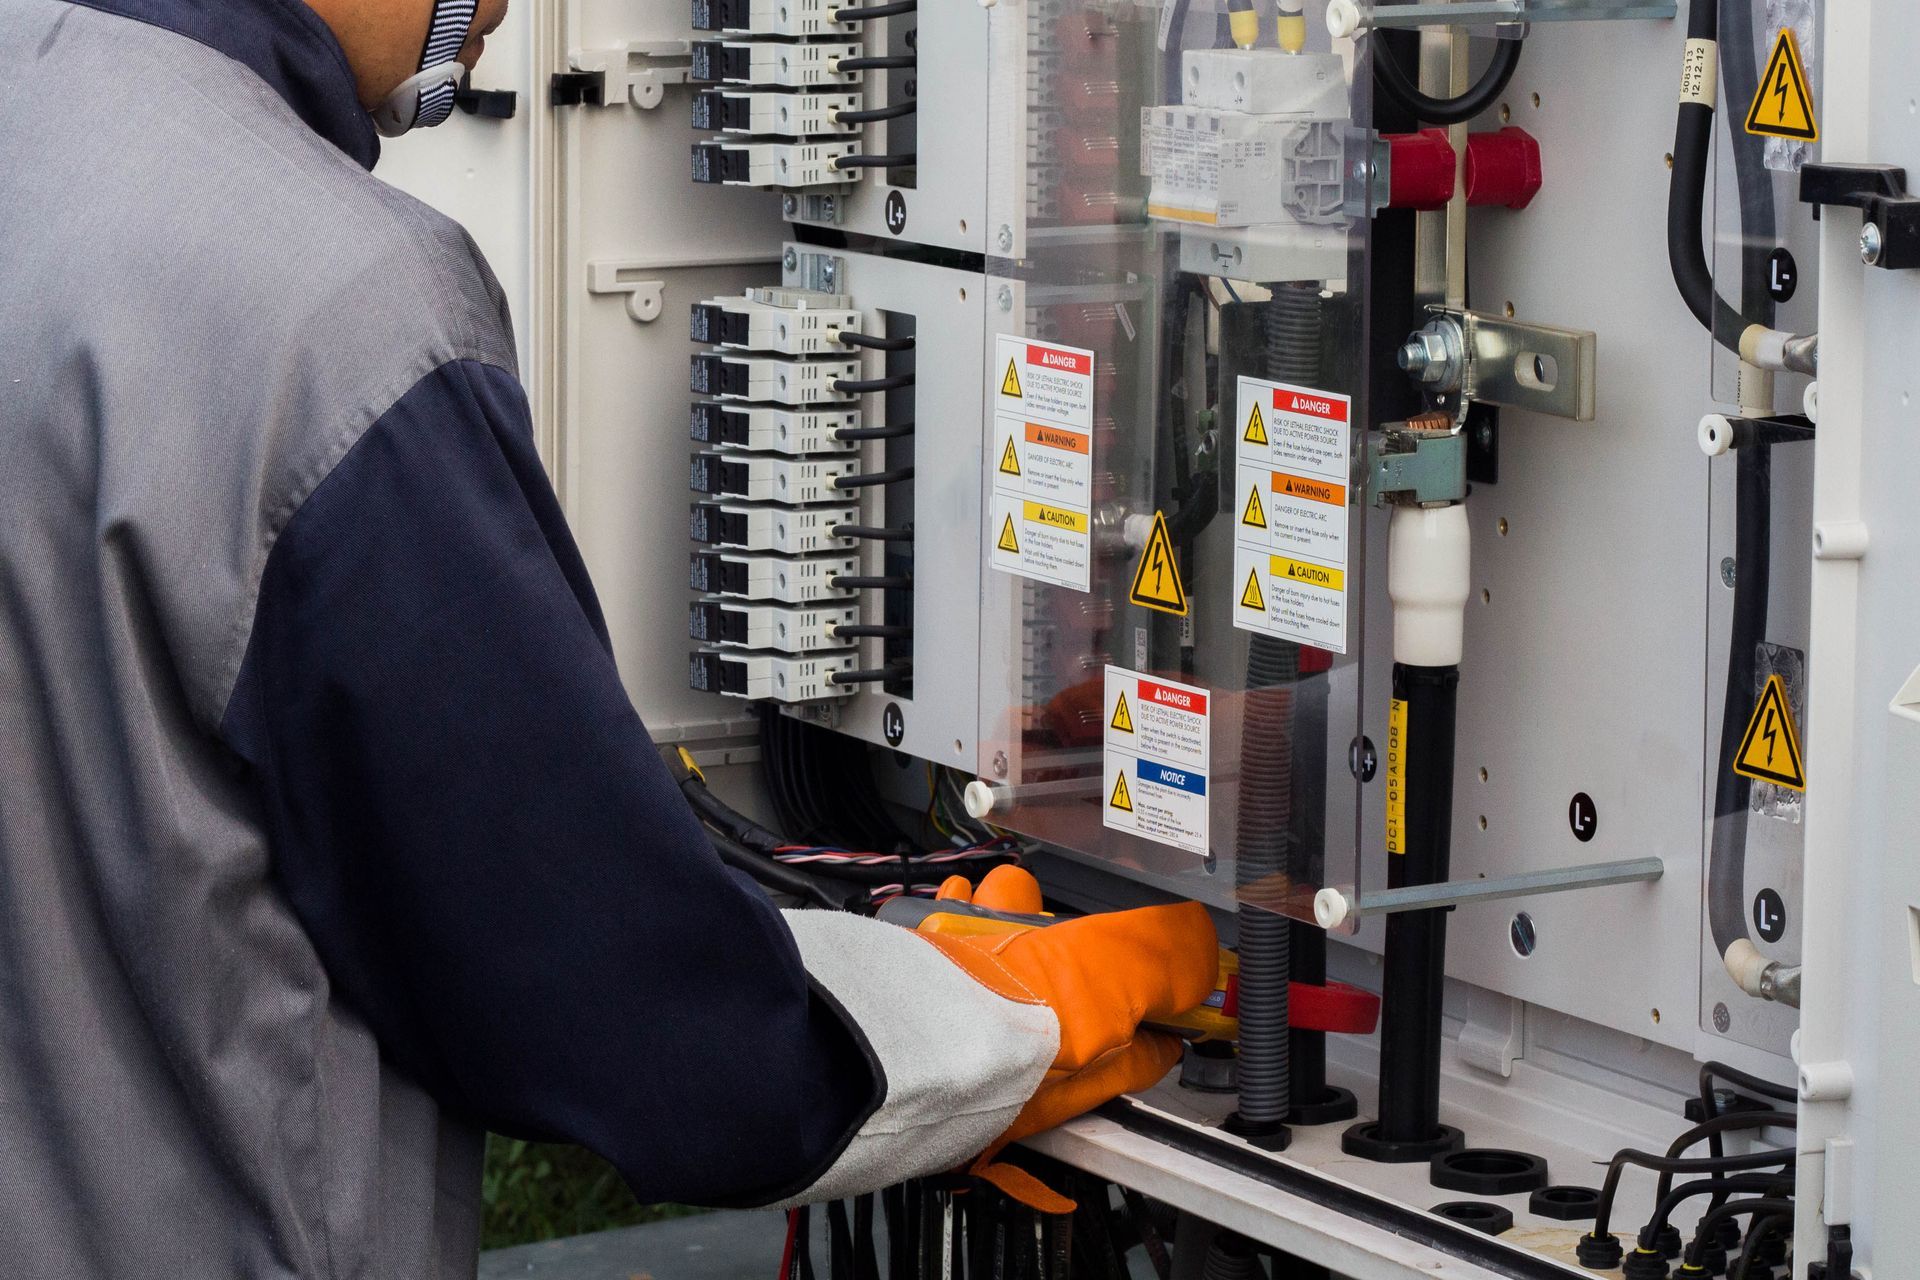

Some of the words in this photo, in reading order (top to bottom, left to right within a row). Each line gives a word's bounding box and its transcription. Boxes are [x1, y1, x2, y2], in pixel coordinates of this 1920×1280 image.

[1682, 50, 1694, 93] 508313
[1692, 47, 1705, 97] 12.12.12
[889, 200, 903, 225] L+
[1772, 259, 1790, 291] L-
[1050, 354, 1076, 369] DANGER
[1300, 399, 1330, 414] DANGER
[1044, 432, 1076, 448] WARNING
[1294, 482, 1330, 499] WARNING
[1047, 511, 1075, 527] CAUTION
[1297, 566, 1329, 583] CAUTION
[1163, 690, 1191, 707] DANGER
[887, 712, 901, 737] L+
[1160, 769, 1185, 785] NOTICE
[1575, 802, 1591, 831] L-
[1760, 899, 1778, 931] L-
